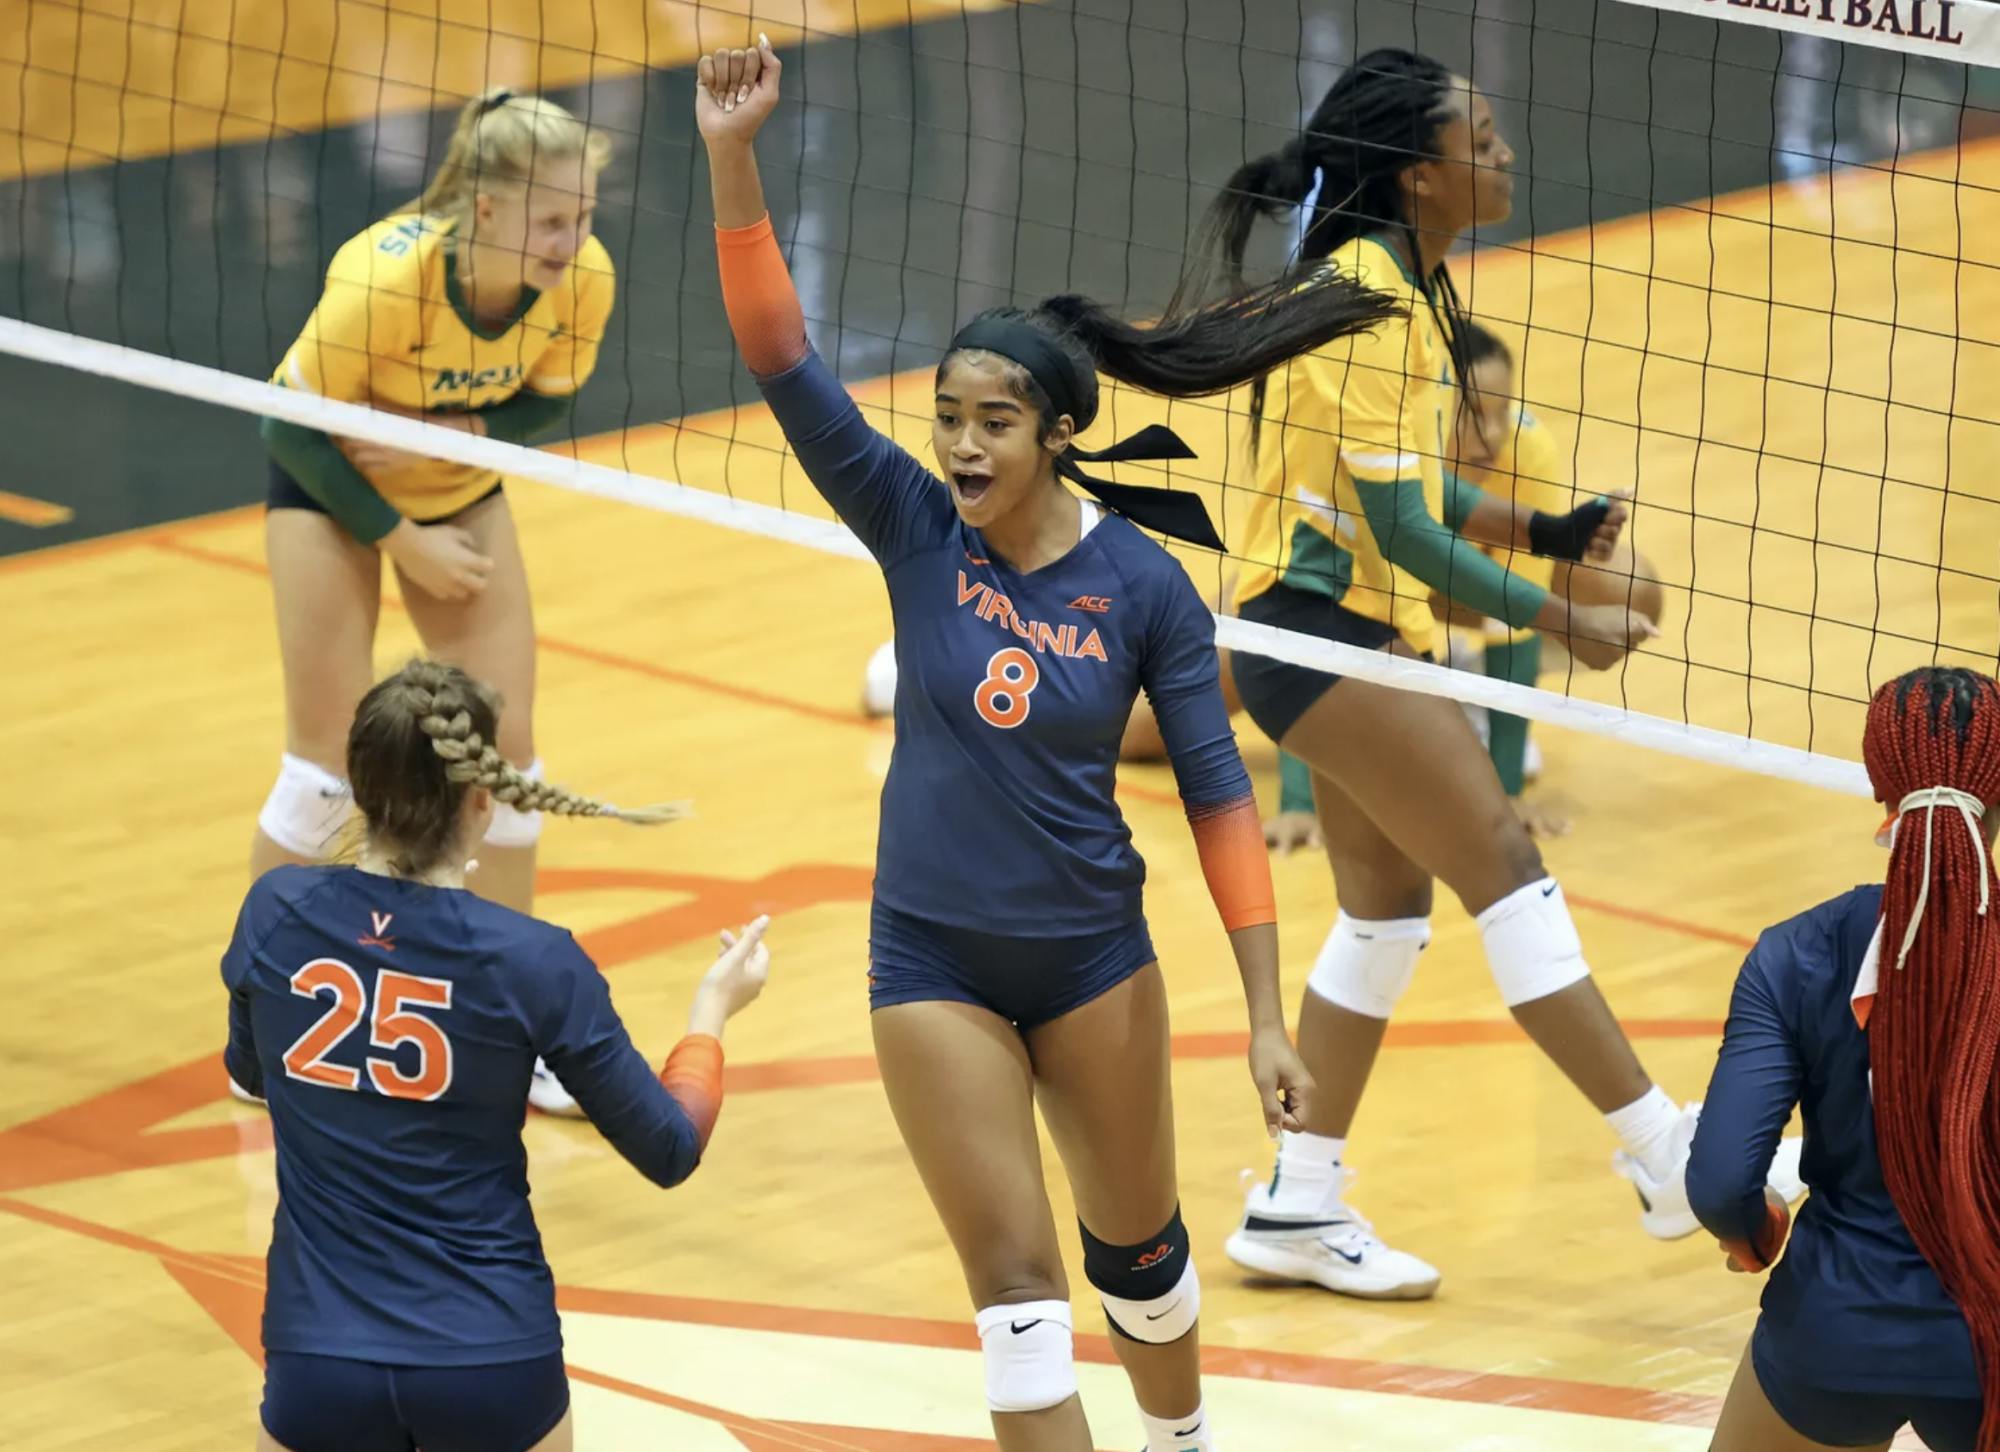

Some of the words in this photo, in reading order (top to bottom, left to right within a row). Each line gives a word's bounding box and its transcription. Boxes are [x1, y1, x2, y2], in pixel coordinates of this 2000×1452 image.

[957, 569, 1108, 663] VIRGINIA
[1068, 595, 1112, 613] ACC
[974, 647, 1039, 729] 8
[371, 911, 393, 937] V
[282, 957, 453, 1101] 25
